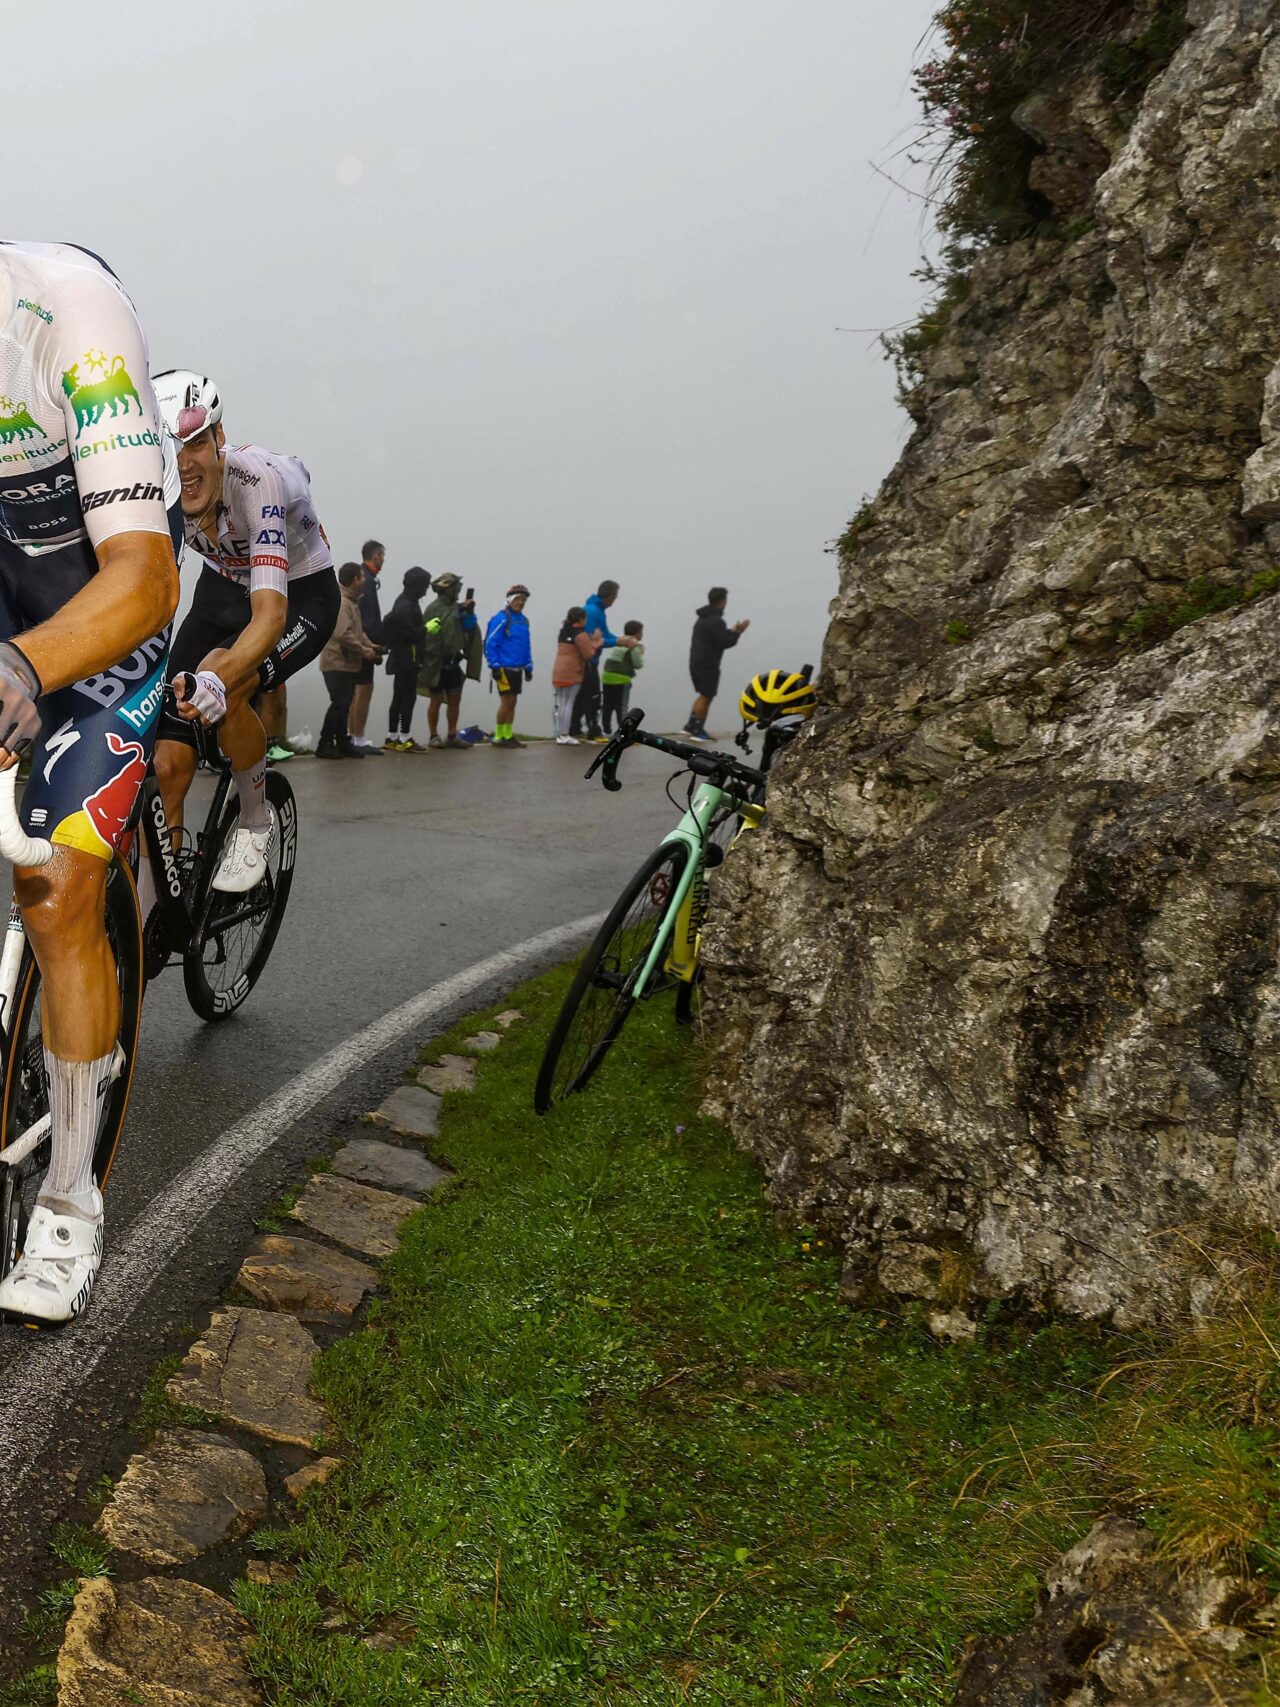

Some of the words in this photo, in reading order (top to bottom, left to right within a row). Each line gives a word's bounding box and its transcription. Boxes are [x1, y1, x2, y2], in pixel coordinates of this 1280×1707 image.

[228, 466, 261, 487] presight
[28, 516, 68, 530] BOSS
[151, 795, 181, 897] COLNAGO
